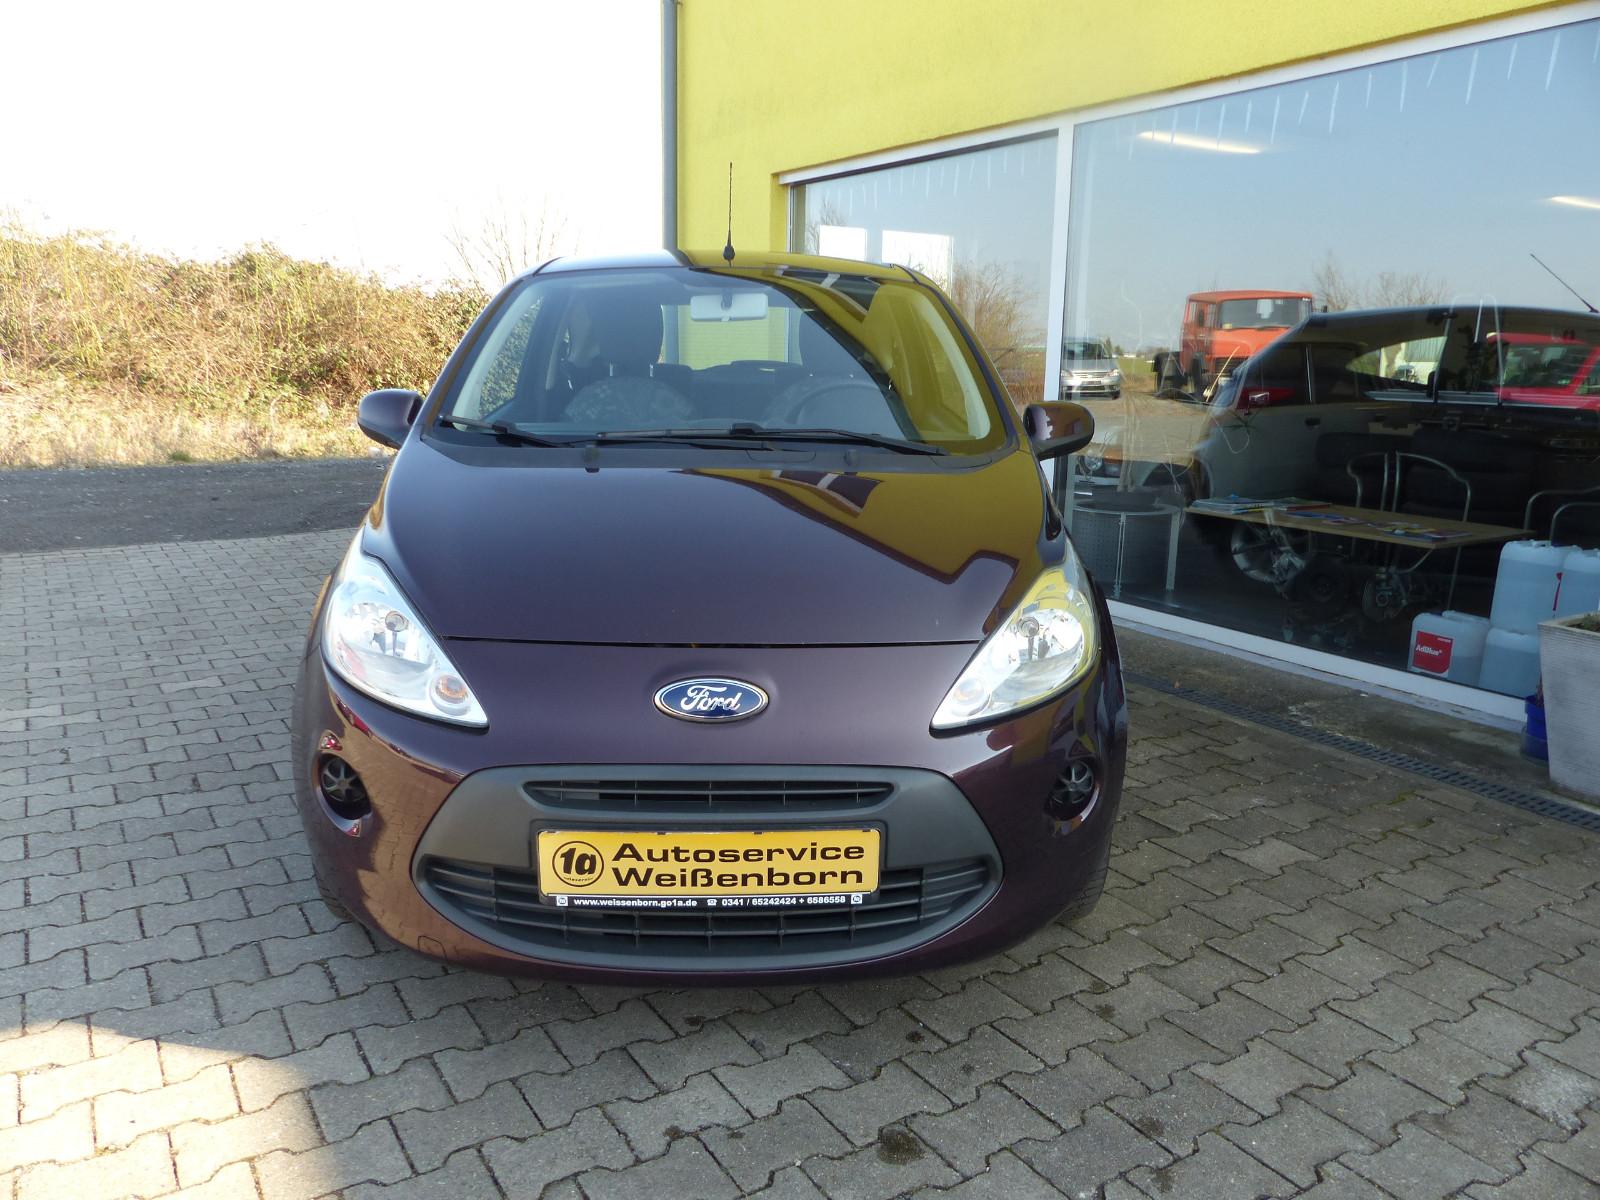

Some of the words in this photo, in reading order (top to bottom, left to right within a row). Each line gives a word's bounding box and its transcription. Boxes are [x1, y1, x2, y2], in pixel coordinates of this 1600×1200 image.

[680, 685, 742, 710] Ford
[560, 848, 596, 875] 1a
[612, 842, 865, 863] Autoservice
[612, 867, 863, 888] Weißenborn
[573, 898, 697, 908] www.weissenborn.go1a.de
[721, 898, 744, 906] 0341
[751, 897, 797, 906] 65242424
[806, 895, 846, 904] 6586558
